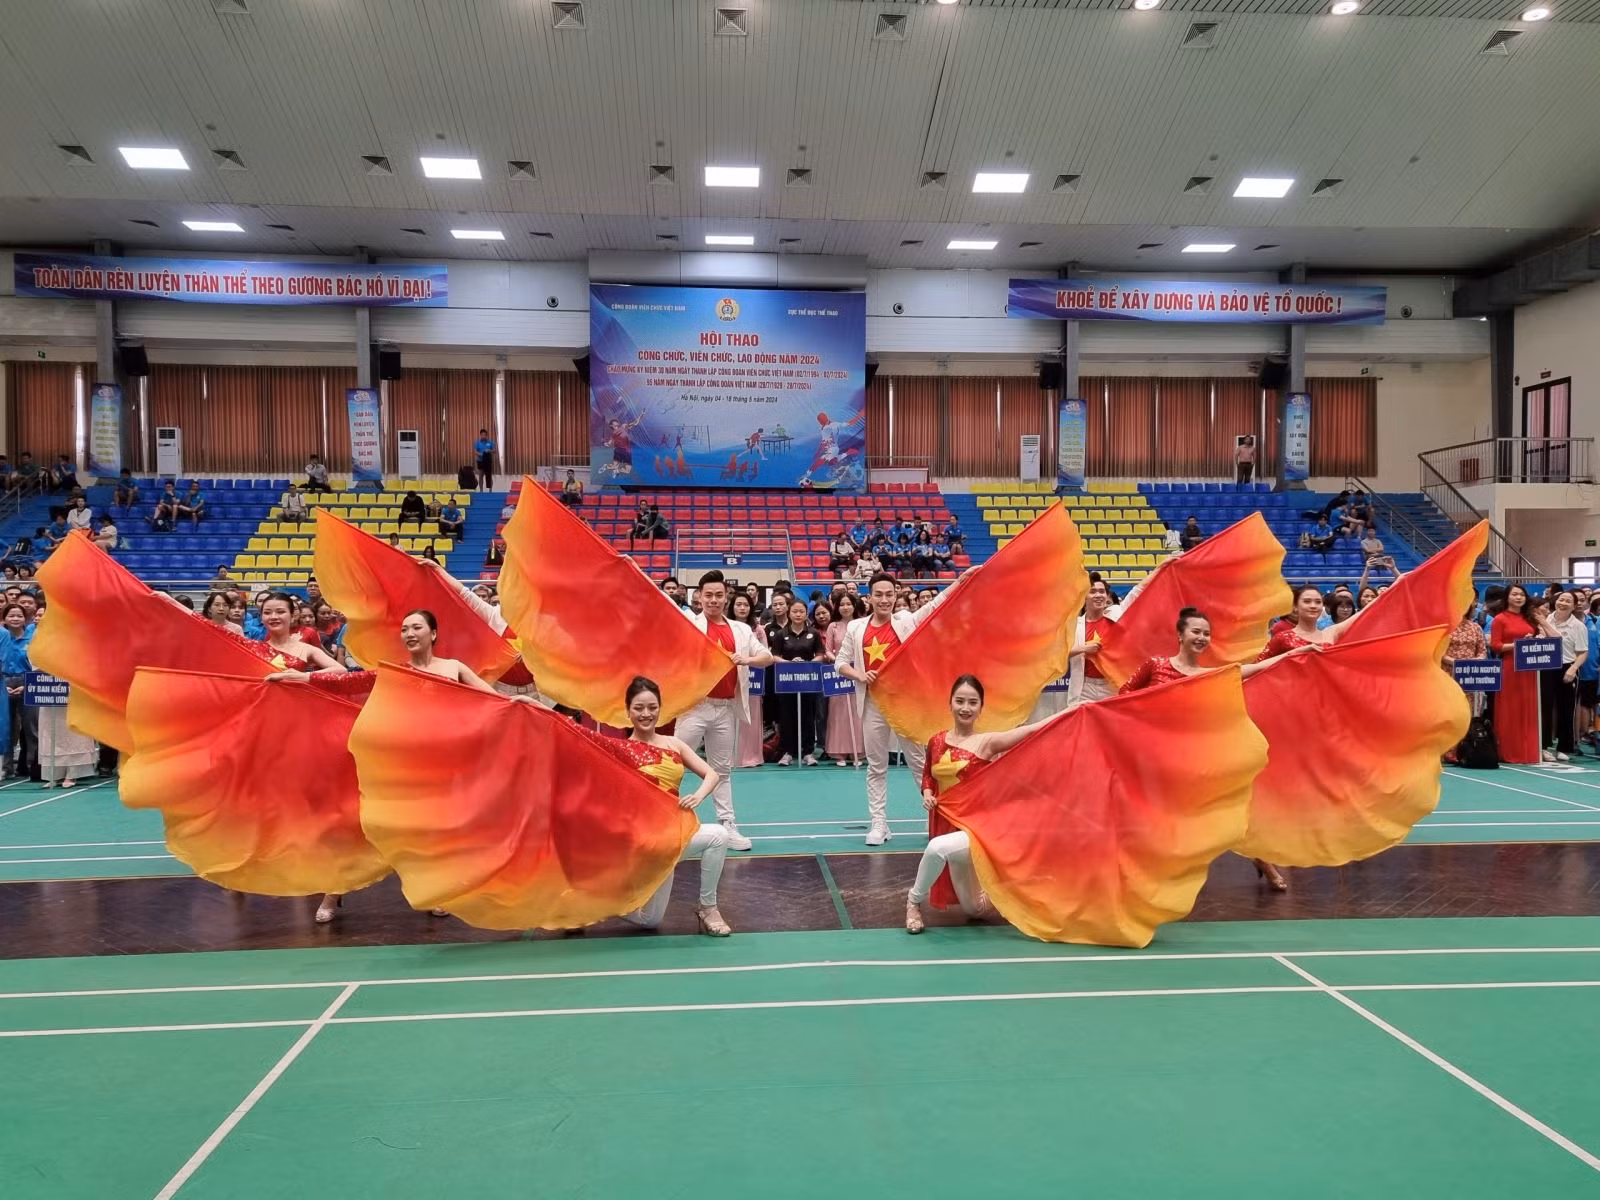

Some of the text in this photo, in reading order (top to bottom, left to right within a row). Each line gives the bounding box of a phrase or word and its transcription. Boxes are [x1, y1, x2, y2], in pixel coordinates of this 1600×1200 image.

[34, 265, 70, 288] TOÀN
[74, 266, 103, 289] DÂN
[106, 267, 134, 290] RÈN
[137, 269, 180, 296] LUYỆN
[183, 271, 219, 293] THÂN
[222, 269, 247, 294] THỂ
[250, 276, 284, 295] THEO
[287, 276, 333, 296] GƯƠNG
[336, 274, 362, 297] BÁC
[366, 272, 384, 297] HỒ
[387, 275, 400, 297] VĨ
[1056, 285, 1095, 308] KHOẺ
[1099, 285, 1119, 309] ĐỂ
[1121, 289, 1150, 310] XÂY
[1153, 292, 1194, 314] DỰNG
[1198, 291, 1216, 311] VÀ
[1220, 289, 1249, 312] BẢO
[1253, 292, 1270, 315] VỆ
[1274, 289, 1293, 313] TỔ
[1295, 290, 1334, 314] QUỐC
[700, 331, 759, 348] HỘI THAO
[638, 350, 820, 365] CÔNG CHỨC, VIÊN CHỨC, LAO ĐỘNG NĂM 2024
[794, 672, 810, 682] TRỌNG
[810, 672, 818, 680] TÀI
[51, 683, 66, 693] KIỂM
[34, 696, 54, 704] TRUNG
